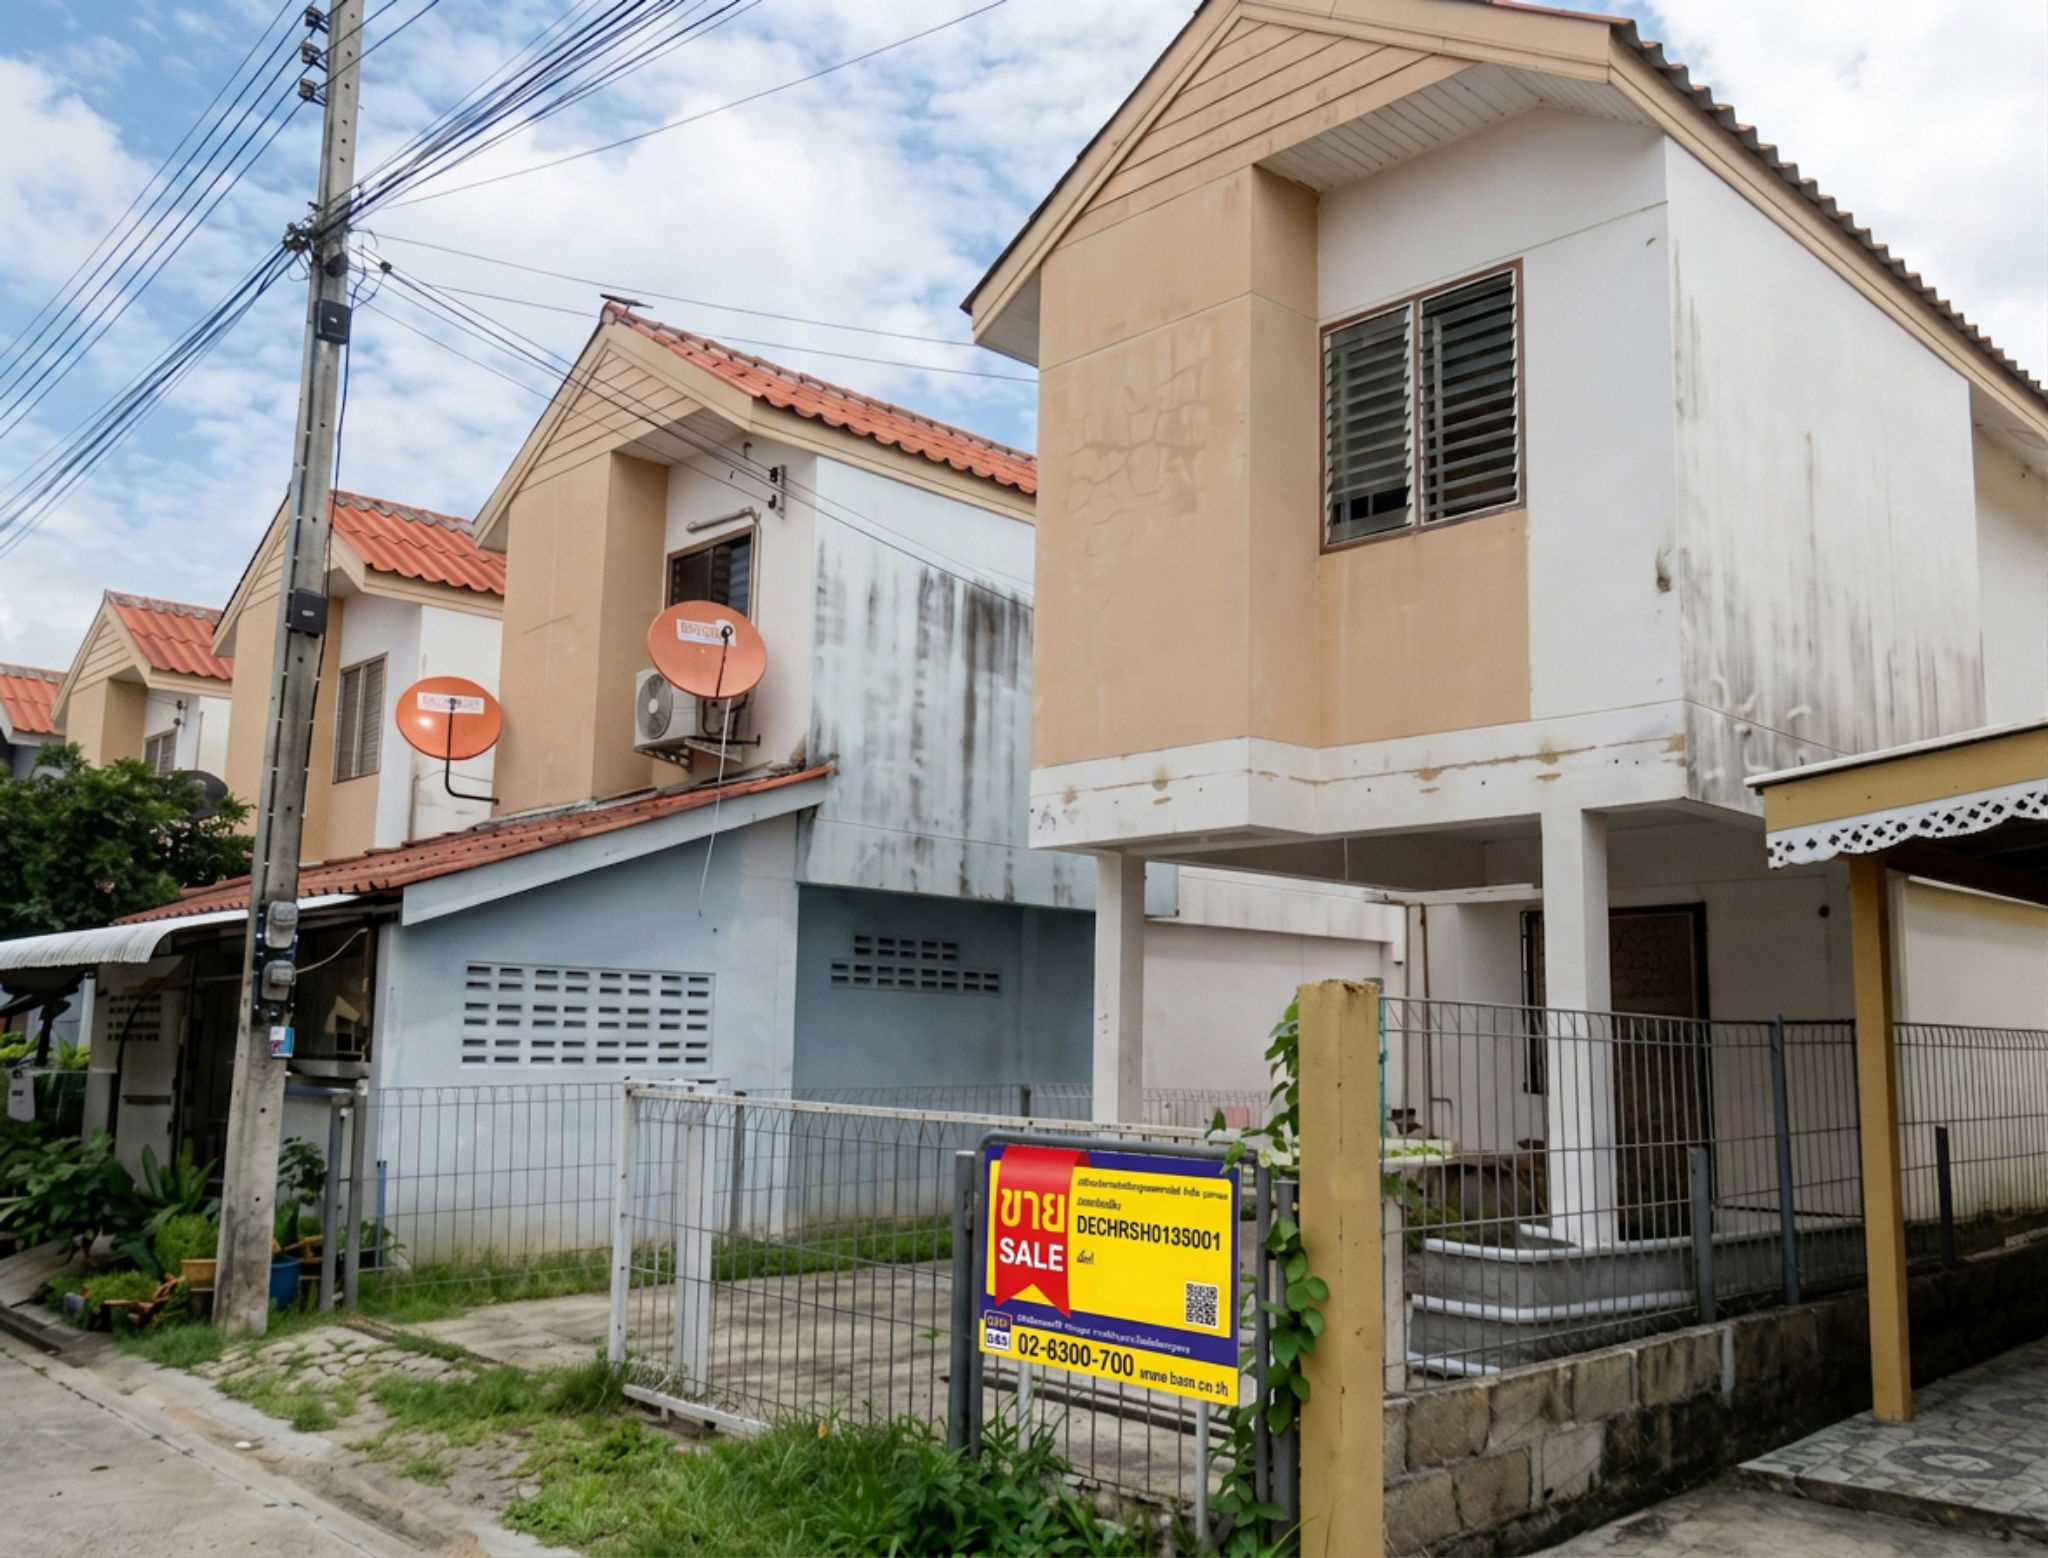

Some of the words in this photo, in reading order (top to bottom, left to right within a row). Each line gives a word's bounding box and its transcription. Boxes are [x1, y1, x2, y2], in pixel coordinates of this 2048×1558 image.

[1001, 1187, 1065, 1233] ขาย
[1077, 1215, 1221, 1251] DECHRSH0135001
[999, 1236, 1064, 1272] SALE
[1018, 1332, 1134, 1377] 02-6300-700
